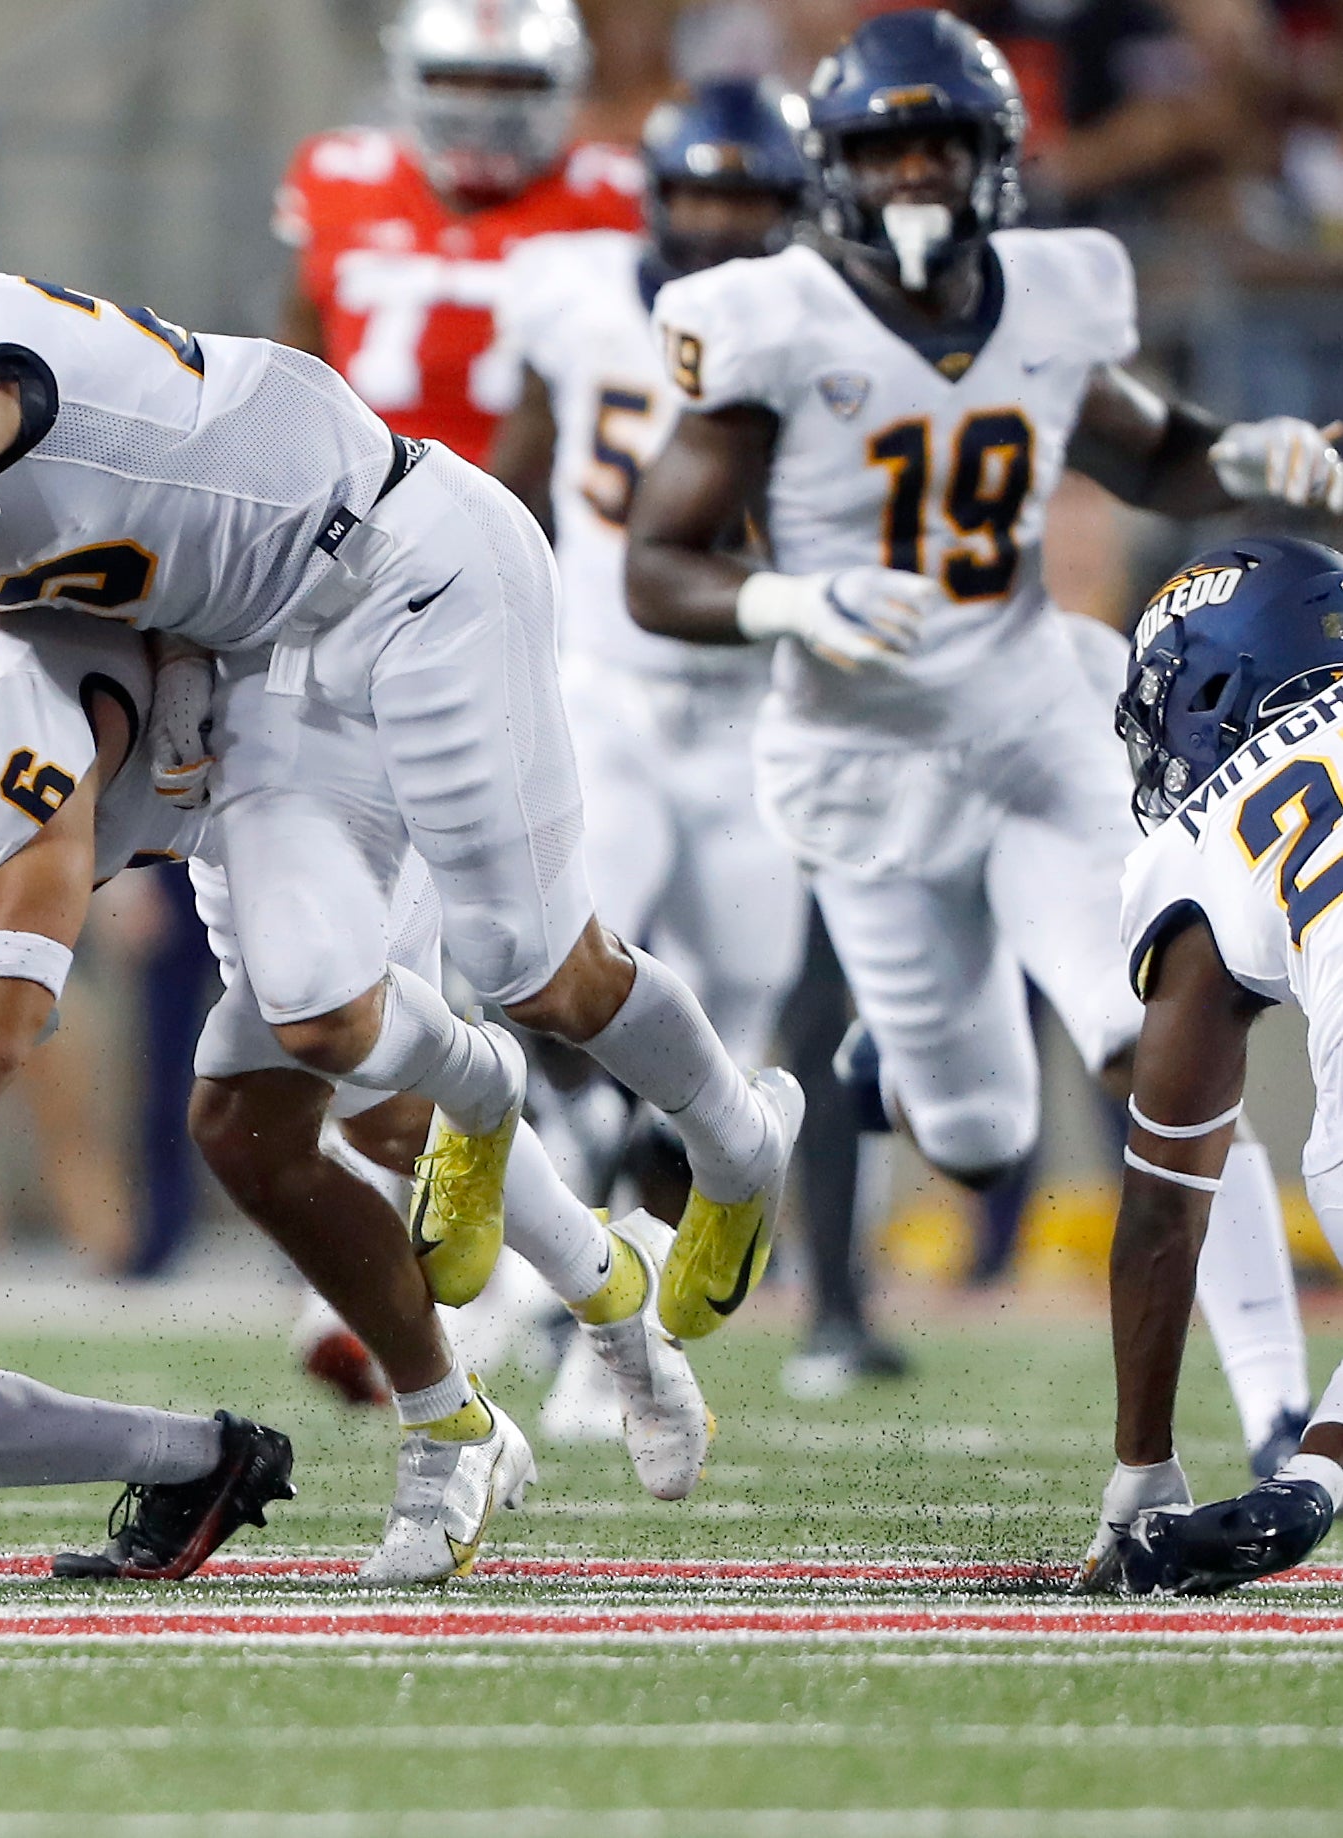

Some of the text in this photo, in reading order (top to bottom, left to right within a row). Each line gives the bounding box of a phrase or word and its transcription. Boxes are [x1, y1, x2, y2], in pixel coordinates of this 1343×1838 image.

[863, 405, 1035, 603] 19
[1134, 567, 1244, 663] TOLEDO
[1231, 755, 1343, 953] 2
